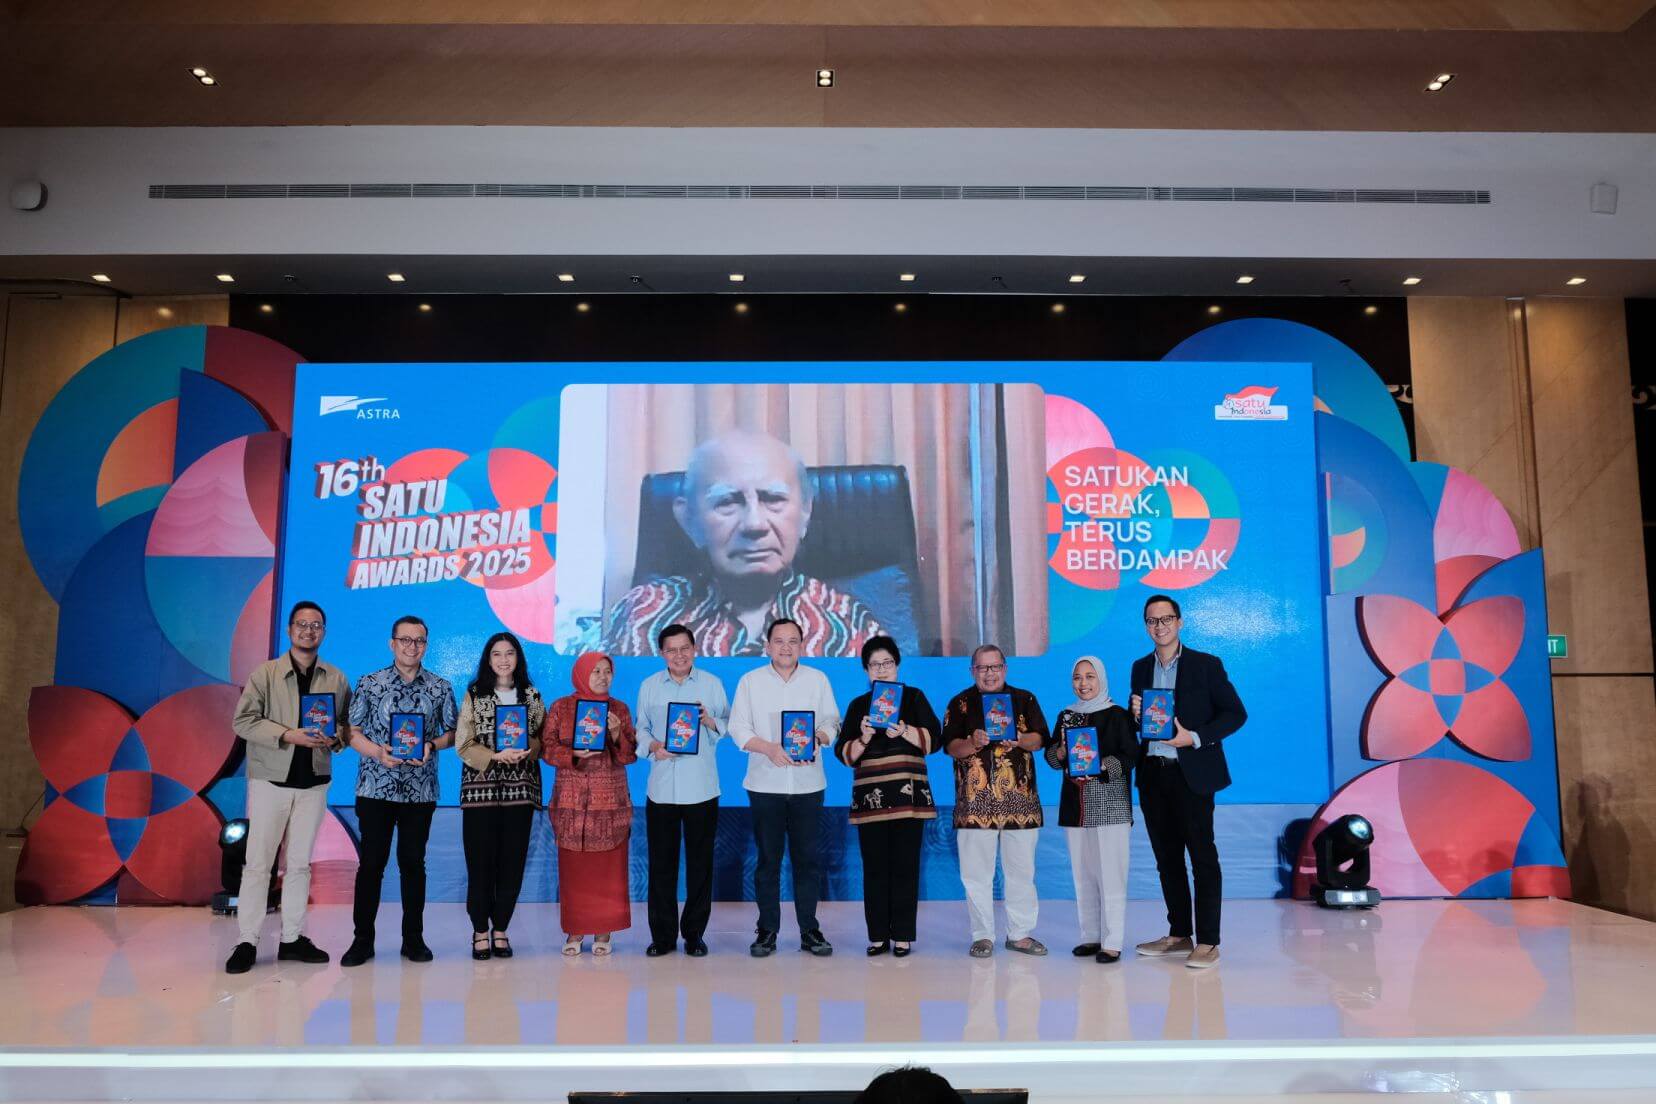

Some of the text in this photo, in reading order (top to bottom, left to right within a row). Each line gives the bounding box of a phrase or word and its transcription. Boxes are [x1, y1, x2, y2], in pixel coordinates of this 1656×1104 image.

[357, 408, 400, 419] ASTRA
[1235, 398, 1266, 408] satu
[315, 456, 386, 500] 16th
[1064, 465, 1189, 487] SATUKAN
[359, 478, 448, 519] SATU
[1064, 493, 1160, 517] GERAK,
[353, 507, 530, 559] INDONESIA
[1064, 521, 1152, 543] TERUS
[347, 547, 532, 590] AWARDS 2025
[1066, 549, 1228, 570] BERDAMPAK
[1547, 639, 1559, 654] IT
